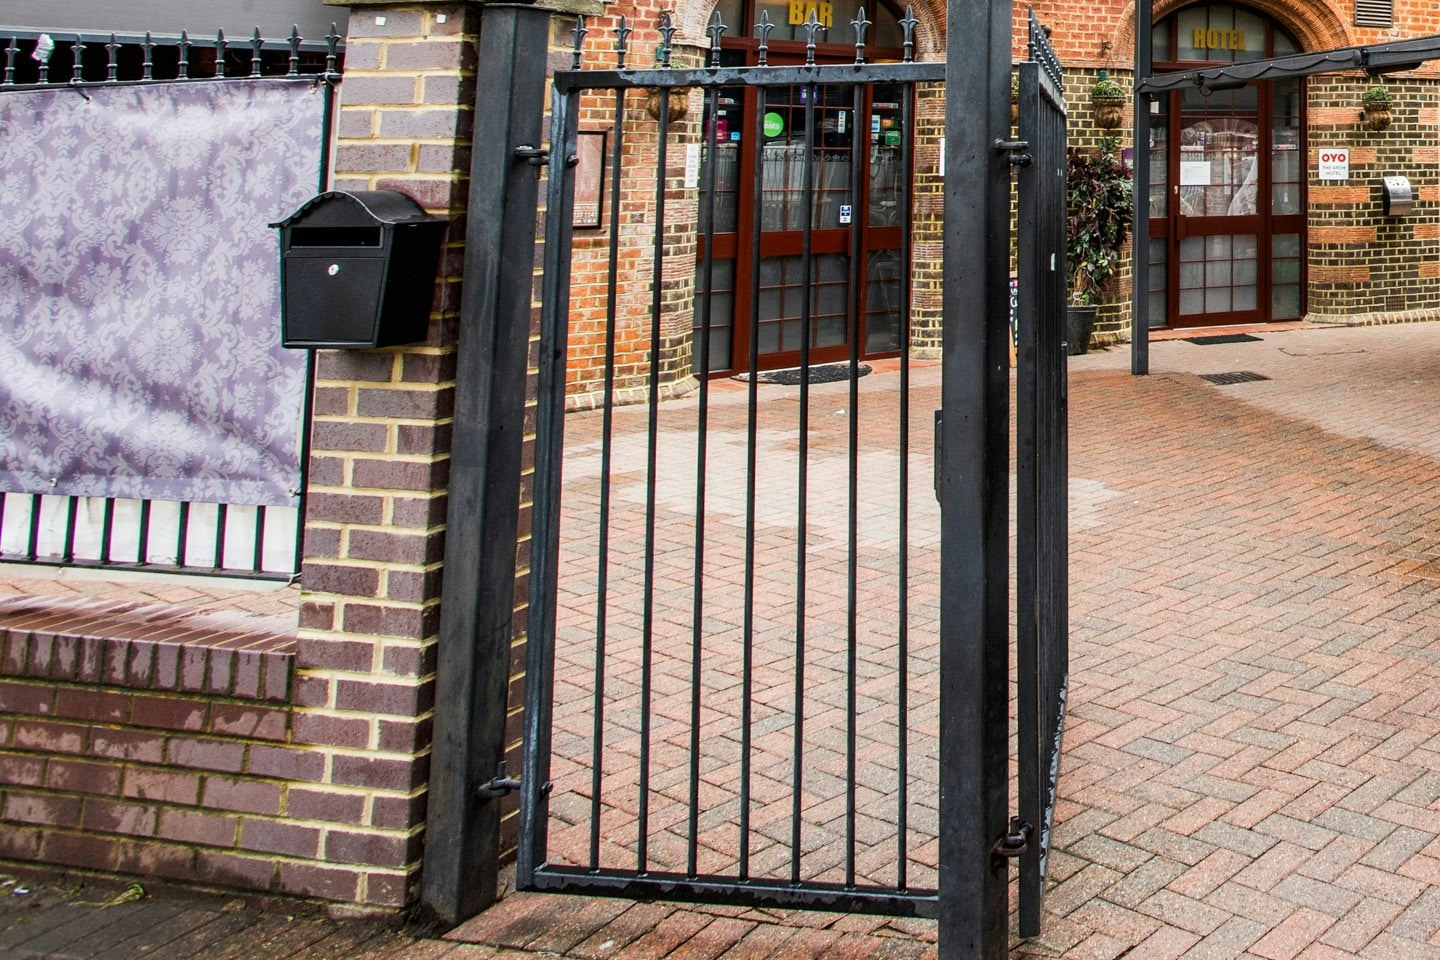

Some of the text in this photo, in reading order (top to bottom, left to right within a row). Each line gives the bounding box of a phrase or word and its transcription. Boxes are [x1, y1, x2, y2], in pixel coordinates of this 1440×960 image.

[788, 0, 833, 28] BAR
[1193, 27, 1247, 50] HOTEL
[1321, 153, 1347, 162] OYO
